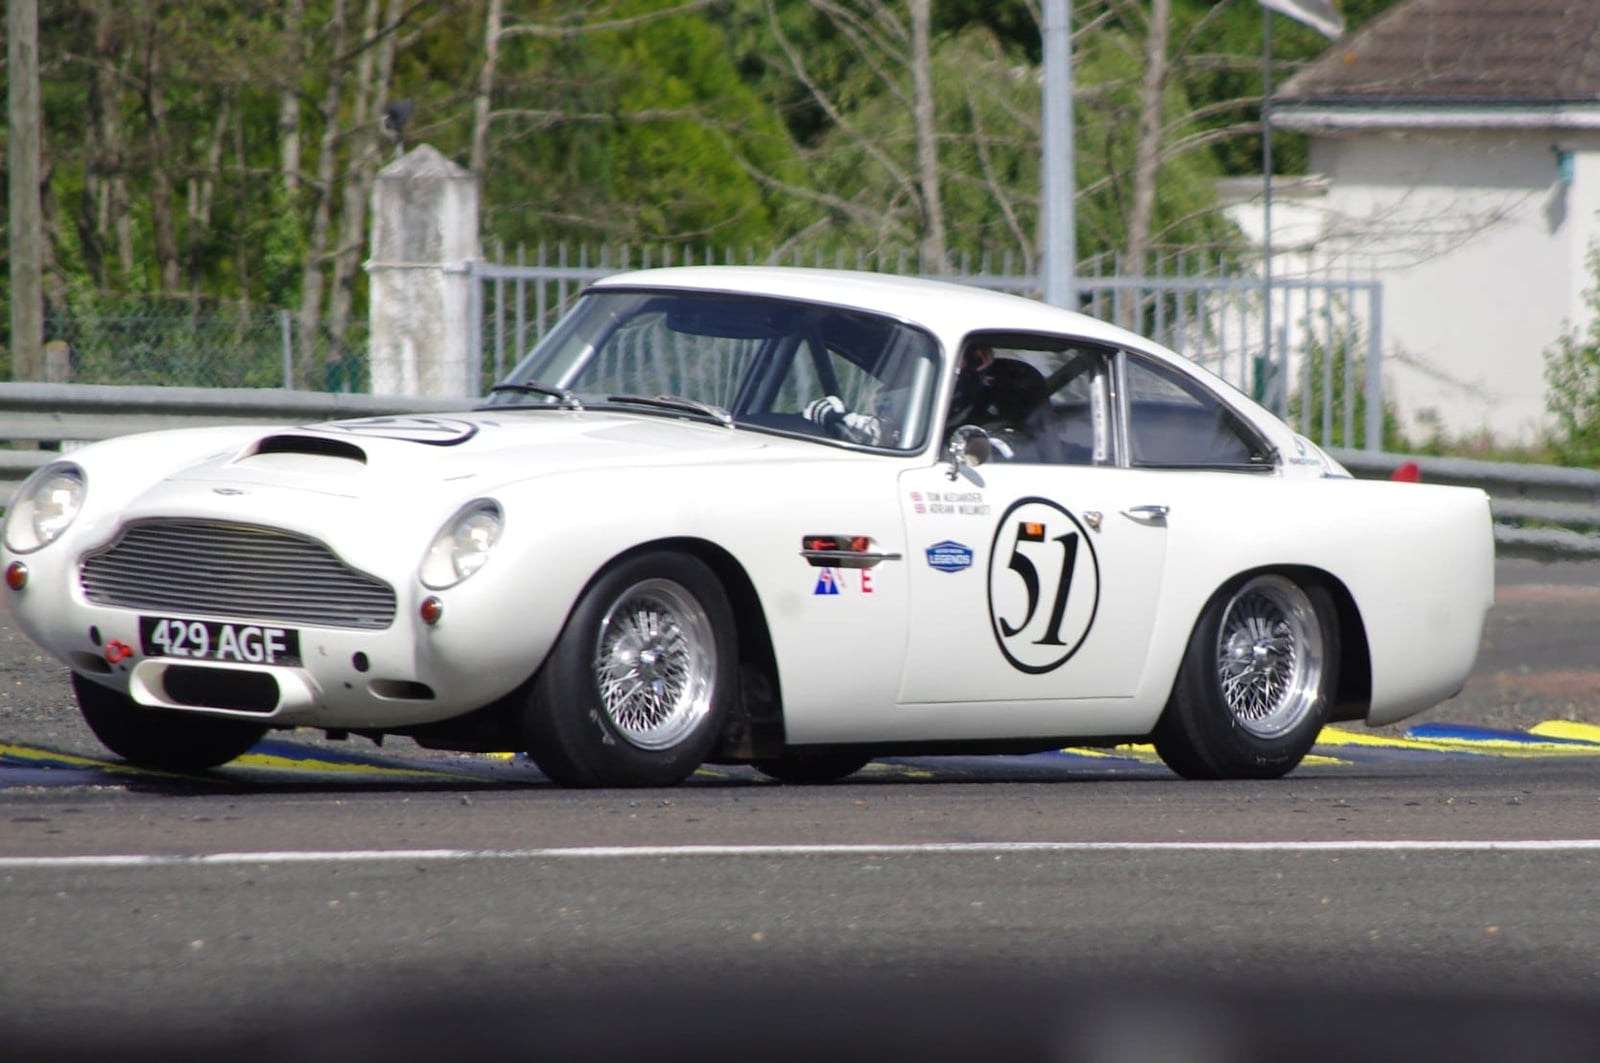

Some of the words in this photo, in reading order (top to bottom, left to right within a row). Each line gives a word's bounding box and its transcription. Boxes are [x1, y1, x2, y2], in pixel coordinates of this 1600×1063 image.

[929, 554, 970, 565] LEGENDS
[999, 521, 1078, 646] 51
[151, 619, 209, 657] 429
[216, 624, 287, 663] AGF
